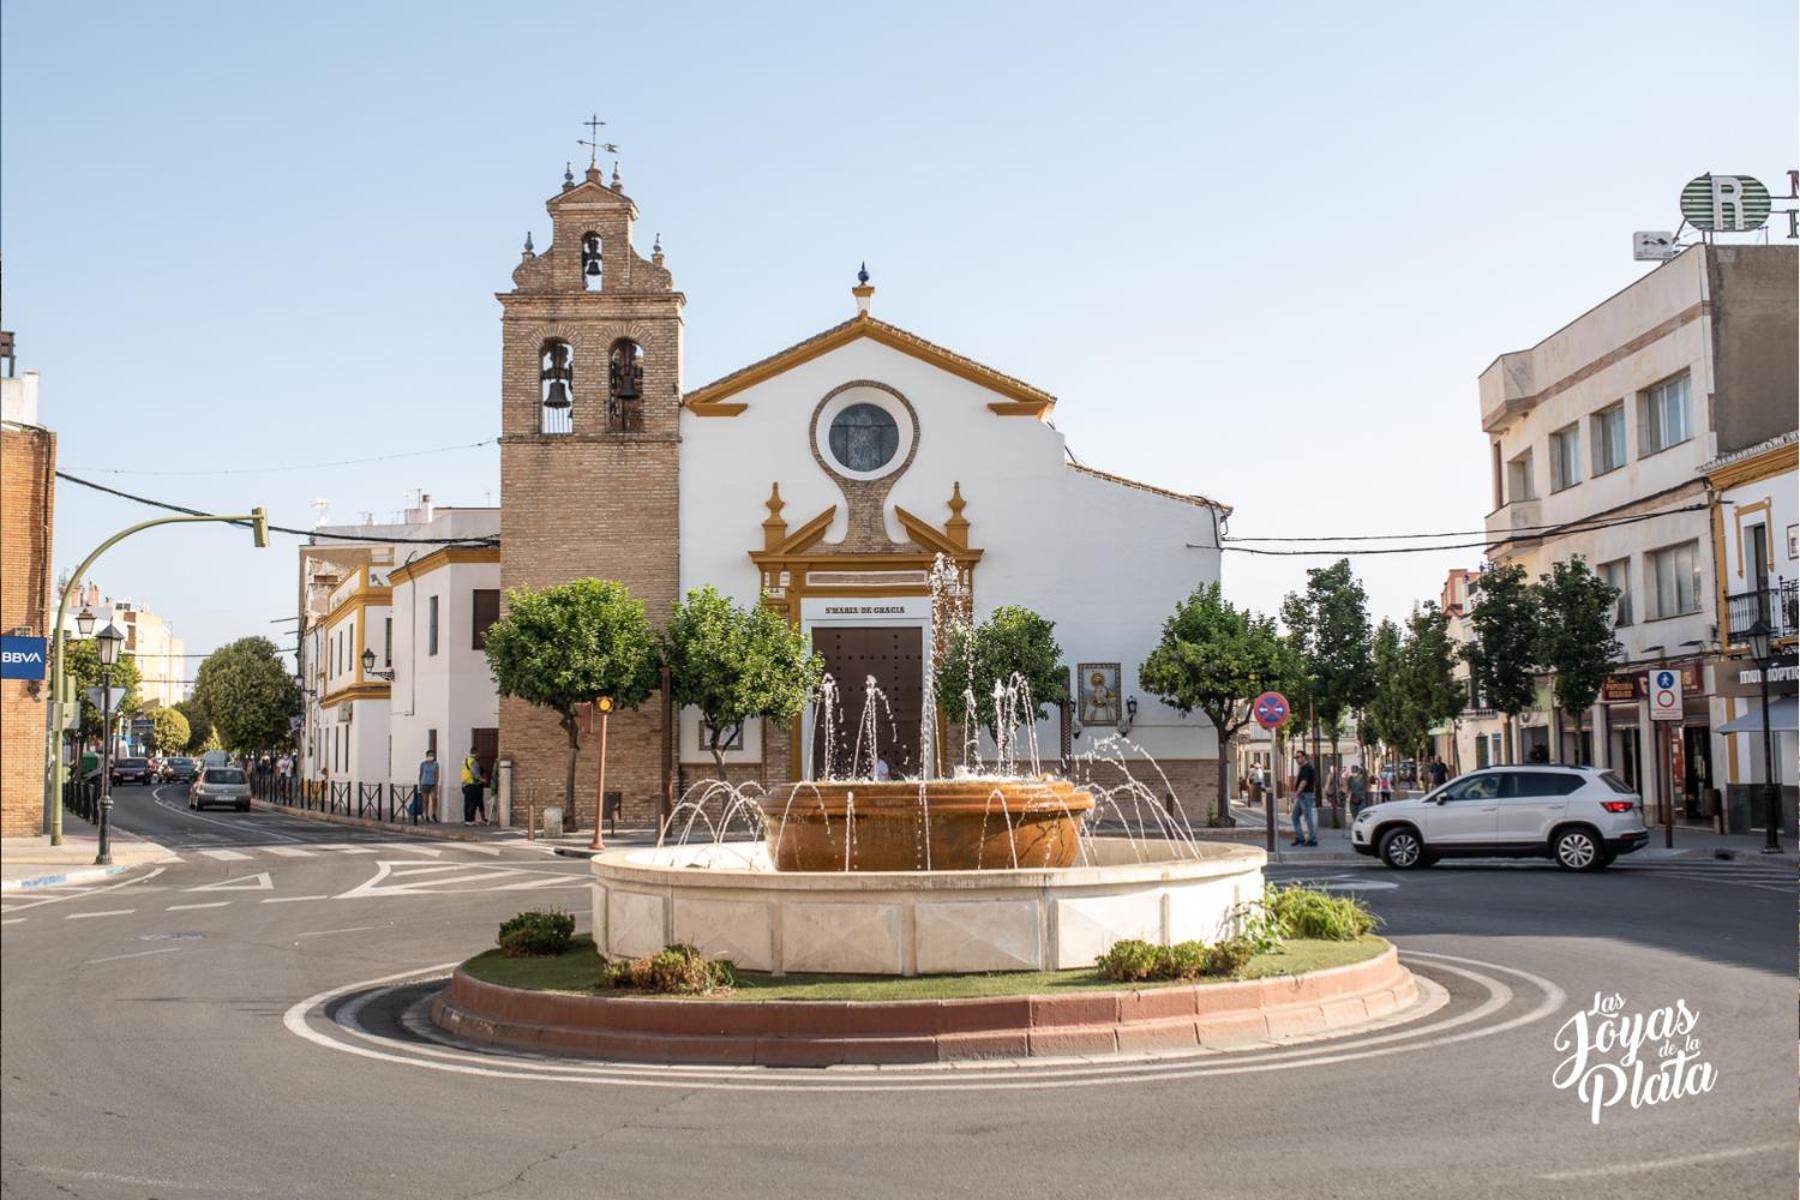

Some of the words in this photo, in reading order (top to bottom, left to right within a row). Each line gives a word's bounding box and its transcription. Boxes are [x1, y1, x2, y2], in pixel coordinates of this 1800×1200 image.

[861, 606, 872, 614] DE
[873, 606, 905, 614] GRACIA
[2, 651, 42, 663] BBVA
